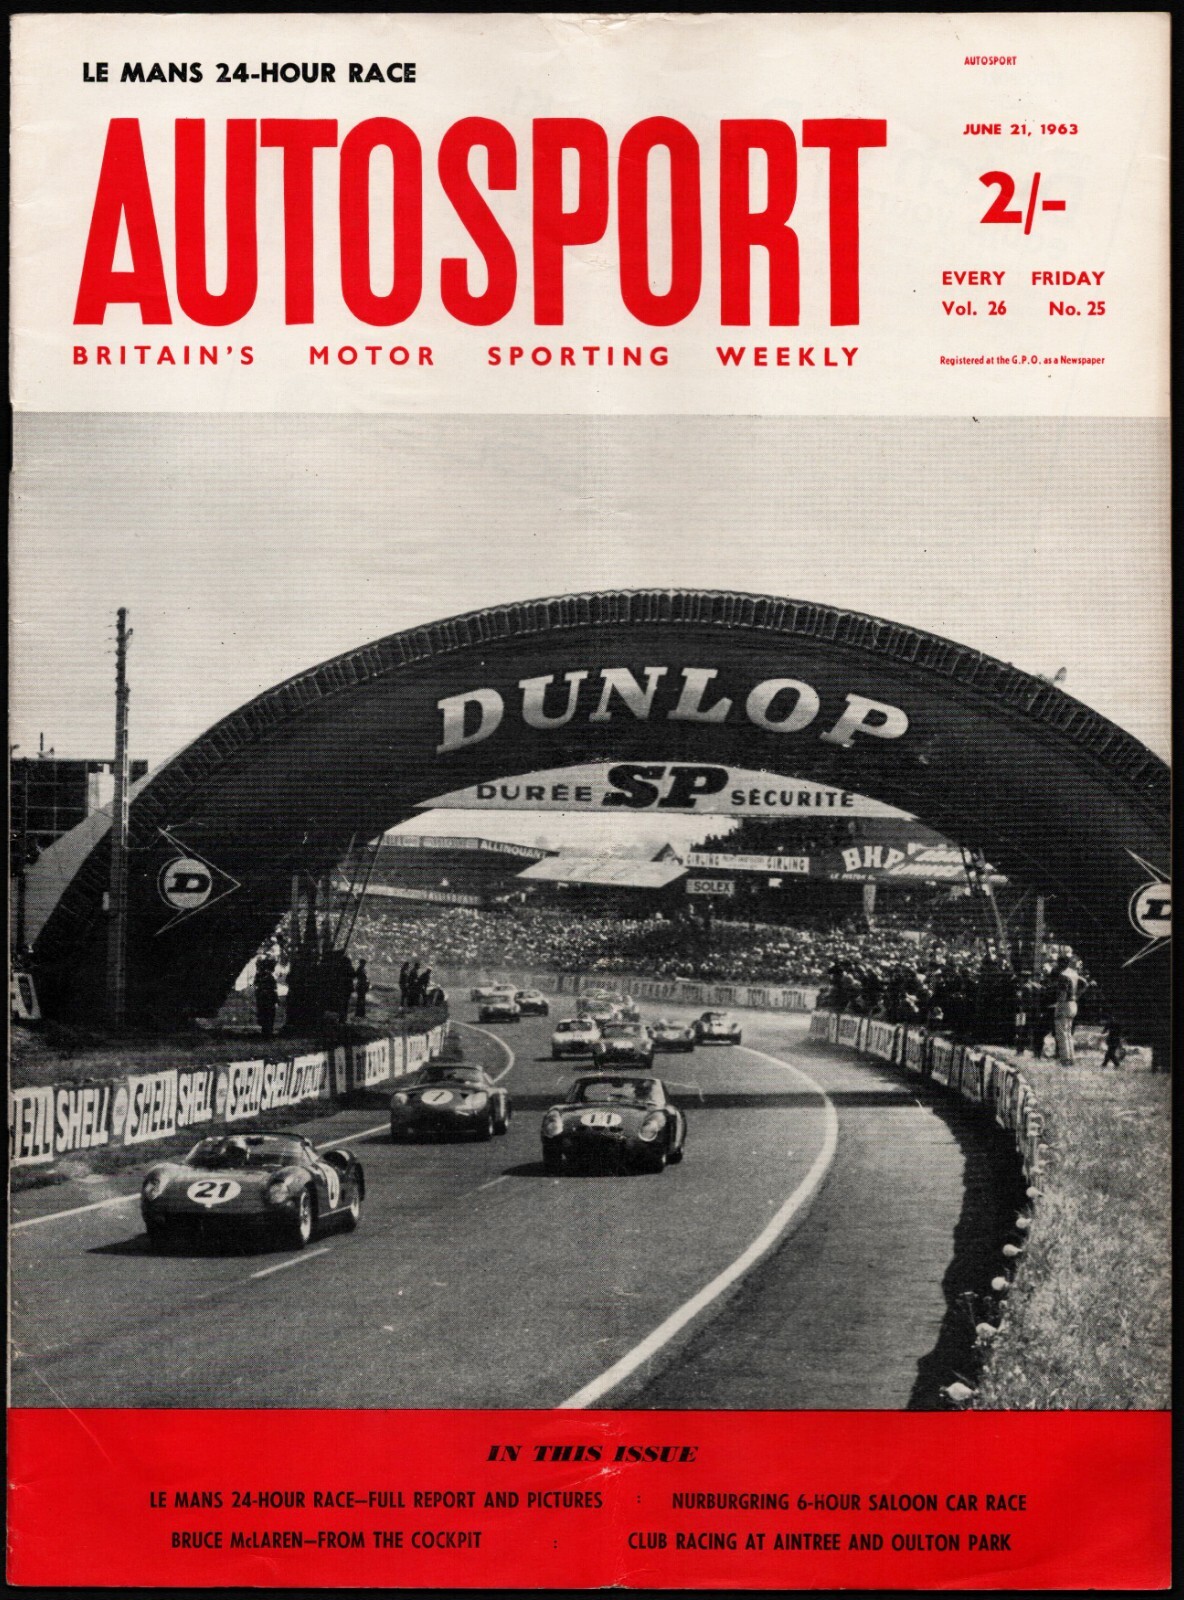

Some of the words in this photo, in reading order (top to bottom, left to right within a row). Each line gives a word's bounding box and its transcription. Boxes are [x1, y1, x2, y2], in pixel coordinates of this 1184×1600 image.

[964, 55, 1017, 66] AUTOSPORT
[84, 63, 108, 82] LE
[121, 63, 202, 83] MANS
[216, 63, 335, 83] 24-HOUR
[349, 63, 416, 83] RACE
[963, 124, 1001, 136] JUNE
[1011, 124, 1031, 137] 21,
[1041, 124, 1078, 136] 1963
[978, 170, 1066, 235] 2/-
[73, 116, 887, 327] AUTOSPORT
[942, 271, 1005, 286] EVERY
[1032, 271, 1105, 286] FRIDAY
[942, 301, 977, 316] Vol.
[988, 301, 1007, 316] 26
[1049, 301, 1081, 316] No.
[1088, 301, 1106, 316] 25
[73, 346, 254, 365] BRITAIN'S
[310, 346, 434, 366] MOTOR
[488, 346, 669, 366] SPORTING
[716, 346, 859, 366] WEEKLY
[940, 355, 985, 367] Registered
[986, 357, 994, 365] at
[996, 356, 1010, 365] the
[1044, 357, 1053, 365] as
[1060, 355, 1105, 366] Newspaper
[436, 666, 909, 754] DUNLOP
[602, 764, 729, 808] SP
[694, 881, 731, 893] SOLEX
[56, 1087, 109, 1152] SHELL
[130, 1078, 173, 1138] SHELL
[178, 1070, 213, 1127] SHELL
[230, 1066, 260, 1116] SHELL
[261, 1062, 292, 1111] SHELL
[194, 1181, 231, 1198] 21
[487, 1446, 521, 1462] IN
[533, 1446, 603, 1462] THIS
[613, 1446, 699, 1463] ISSUE
[150, 1491, 167, 1508] LE
[174, 1491, 223, 1508] MANS
[231, 1491, 306, 1508] 24-HOUR
[413, 1491, 476, 1508] REPORT
[484, 1491, 520, 1508] AND
[527, 1491, 603, 1508] PICTURES
[672, 1493, 790, 1510] NURBURGRING
[797, 1493, 861, 1511] 6-HOUR
[869, 1494, 938, 1511] SALOON
[945, 1494, 978, 1511] CAR
[986, 1494, 1027, 1511] RACE
[171, 1531, 223, 1549] BRUCE
[373, 1531, 403, 1549] THE
[411, 1531, 482, 1548] COCKPIT
[628, 1532, 667, 1550] CLUB
[676, 1532, 737, 1550] RACING
[745, 1533, 766, 1550] AT
[773, 1533, 841, 1550] AINTREE
[848, 1534, 884, 1551] AND
[891, 1534, 960, 1551] OULTON
[968, 1534, 1012, 1551] PARK
